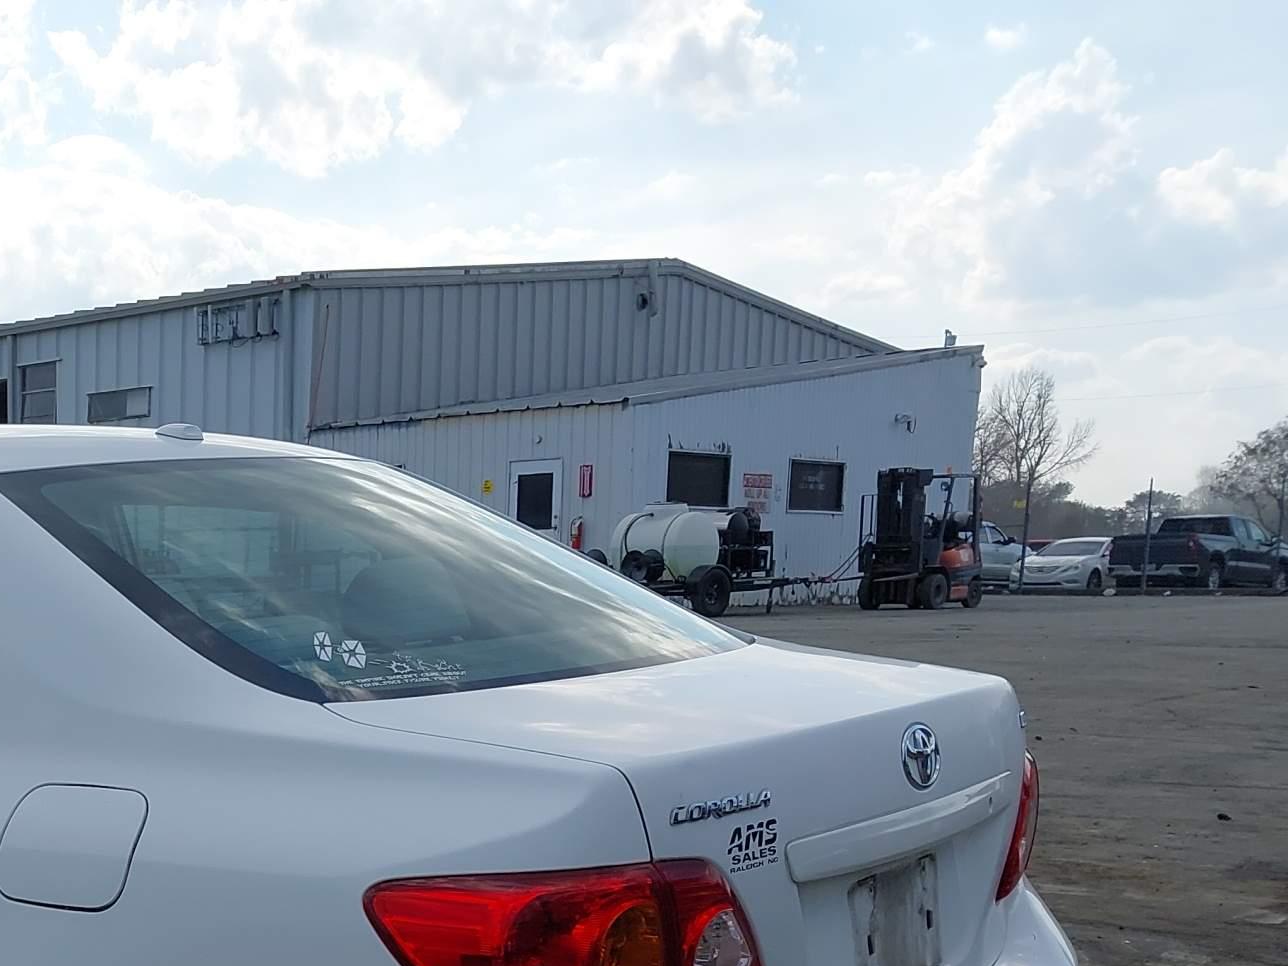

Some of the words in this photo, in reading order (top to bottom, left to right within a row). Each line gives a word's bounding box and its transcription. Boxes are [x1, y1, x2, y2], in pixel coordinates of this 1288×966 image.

[670, 790, 771, 826] COROLLA
[727, 818, 778, 855] AMS
[731, 846, 777, 866] SALES
